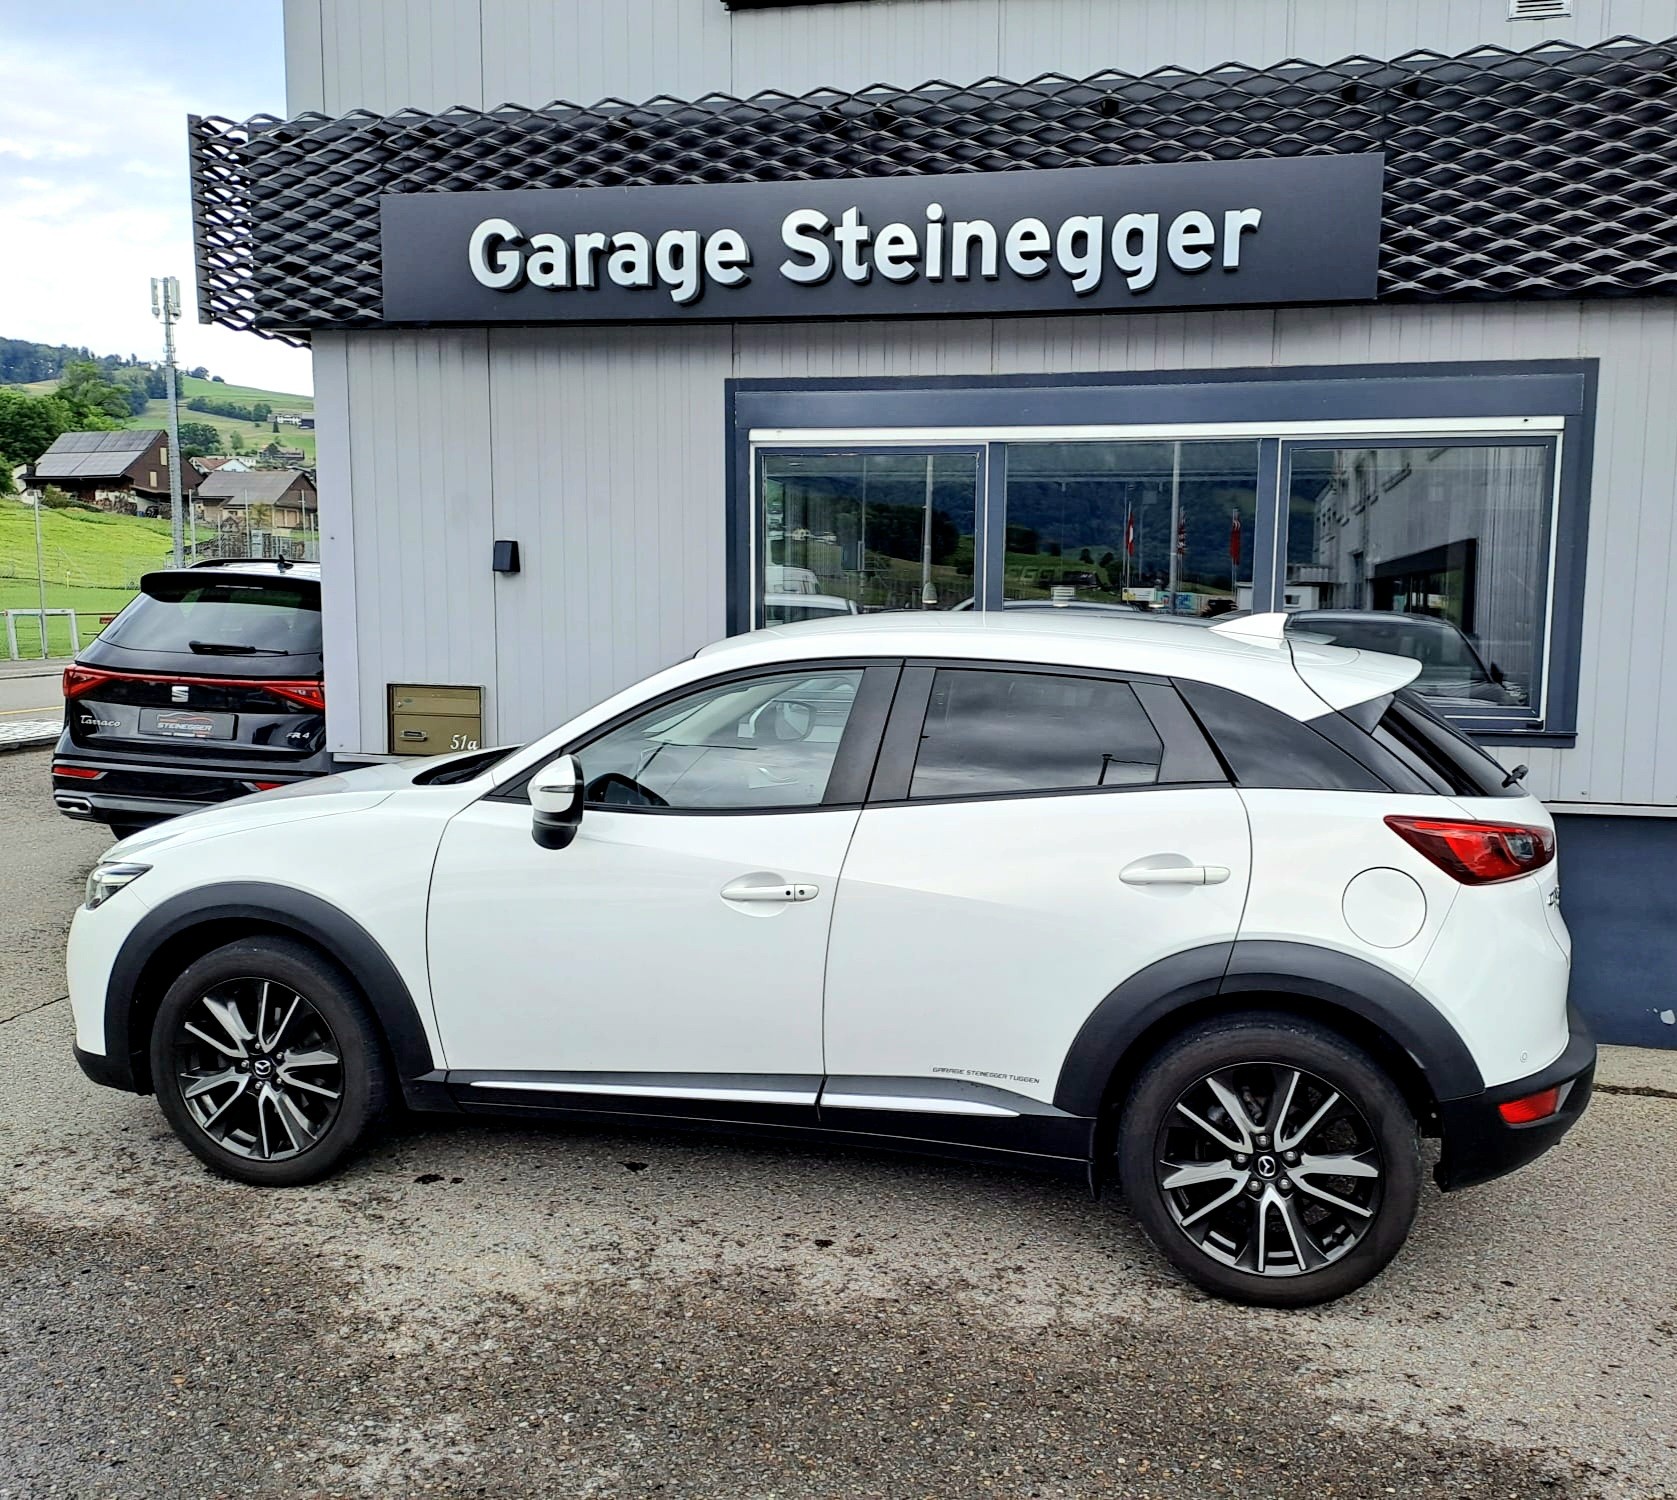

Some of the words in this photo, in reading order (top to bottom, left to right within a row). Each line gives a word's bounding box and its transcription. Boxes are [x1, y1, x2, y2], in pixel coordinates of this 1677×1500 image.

[468, 217, 751, 304] Garage
[779, 203, 1262, 294] Steinegger
[80, 715, 121, 727] Tarraco
[450, 734, 479, 751] 51a
[932, 1067, 965, 1075] GARAGE
[966, 1069, 1008, 1080] STEINEGGER
[1009, 1074, 1040, 1084] TUGGEN
